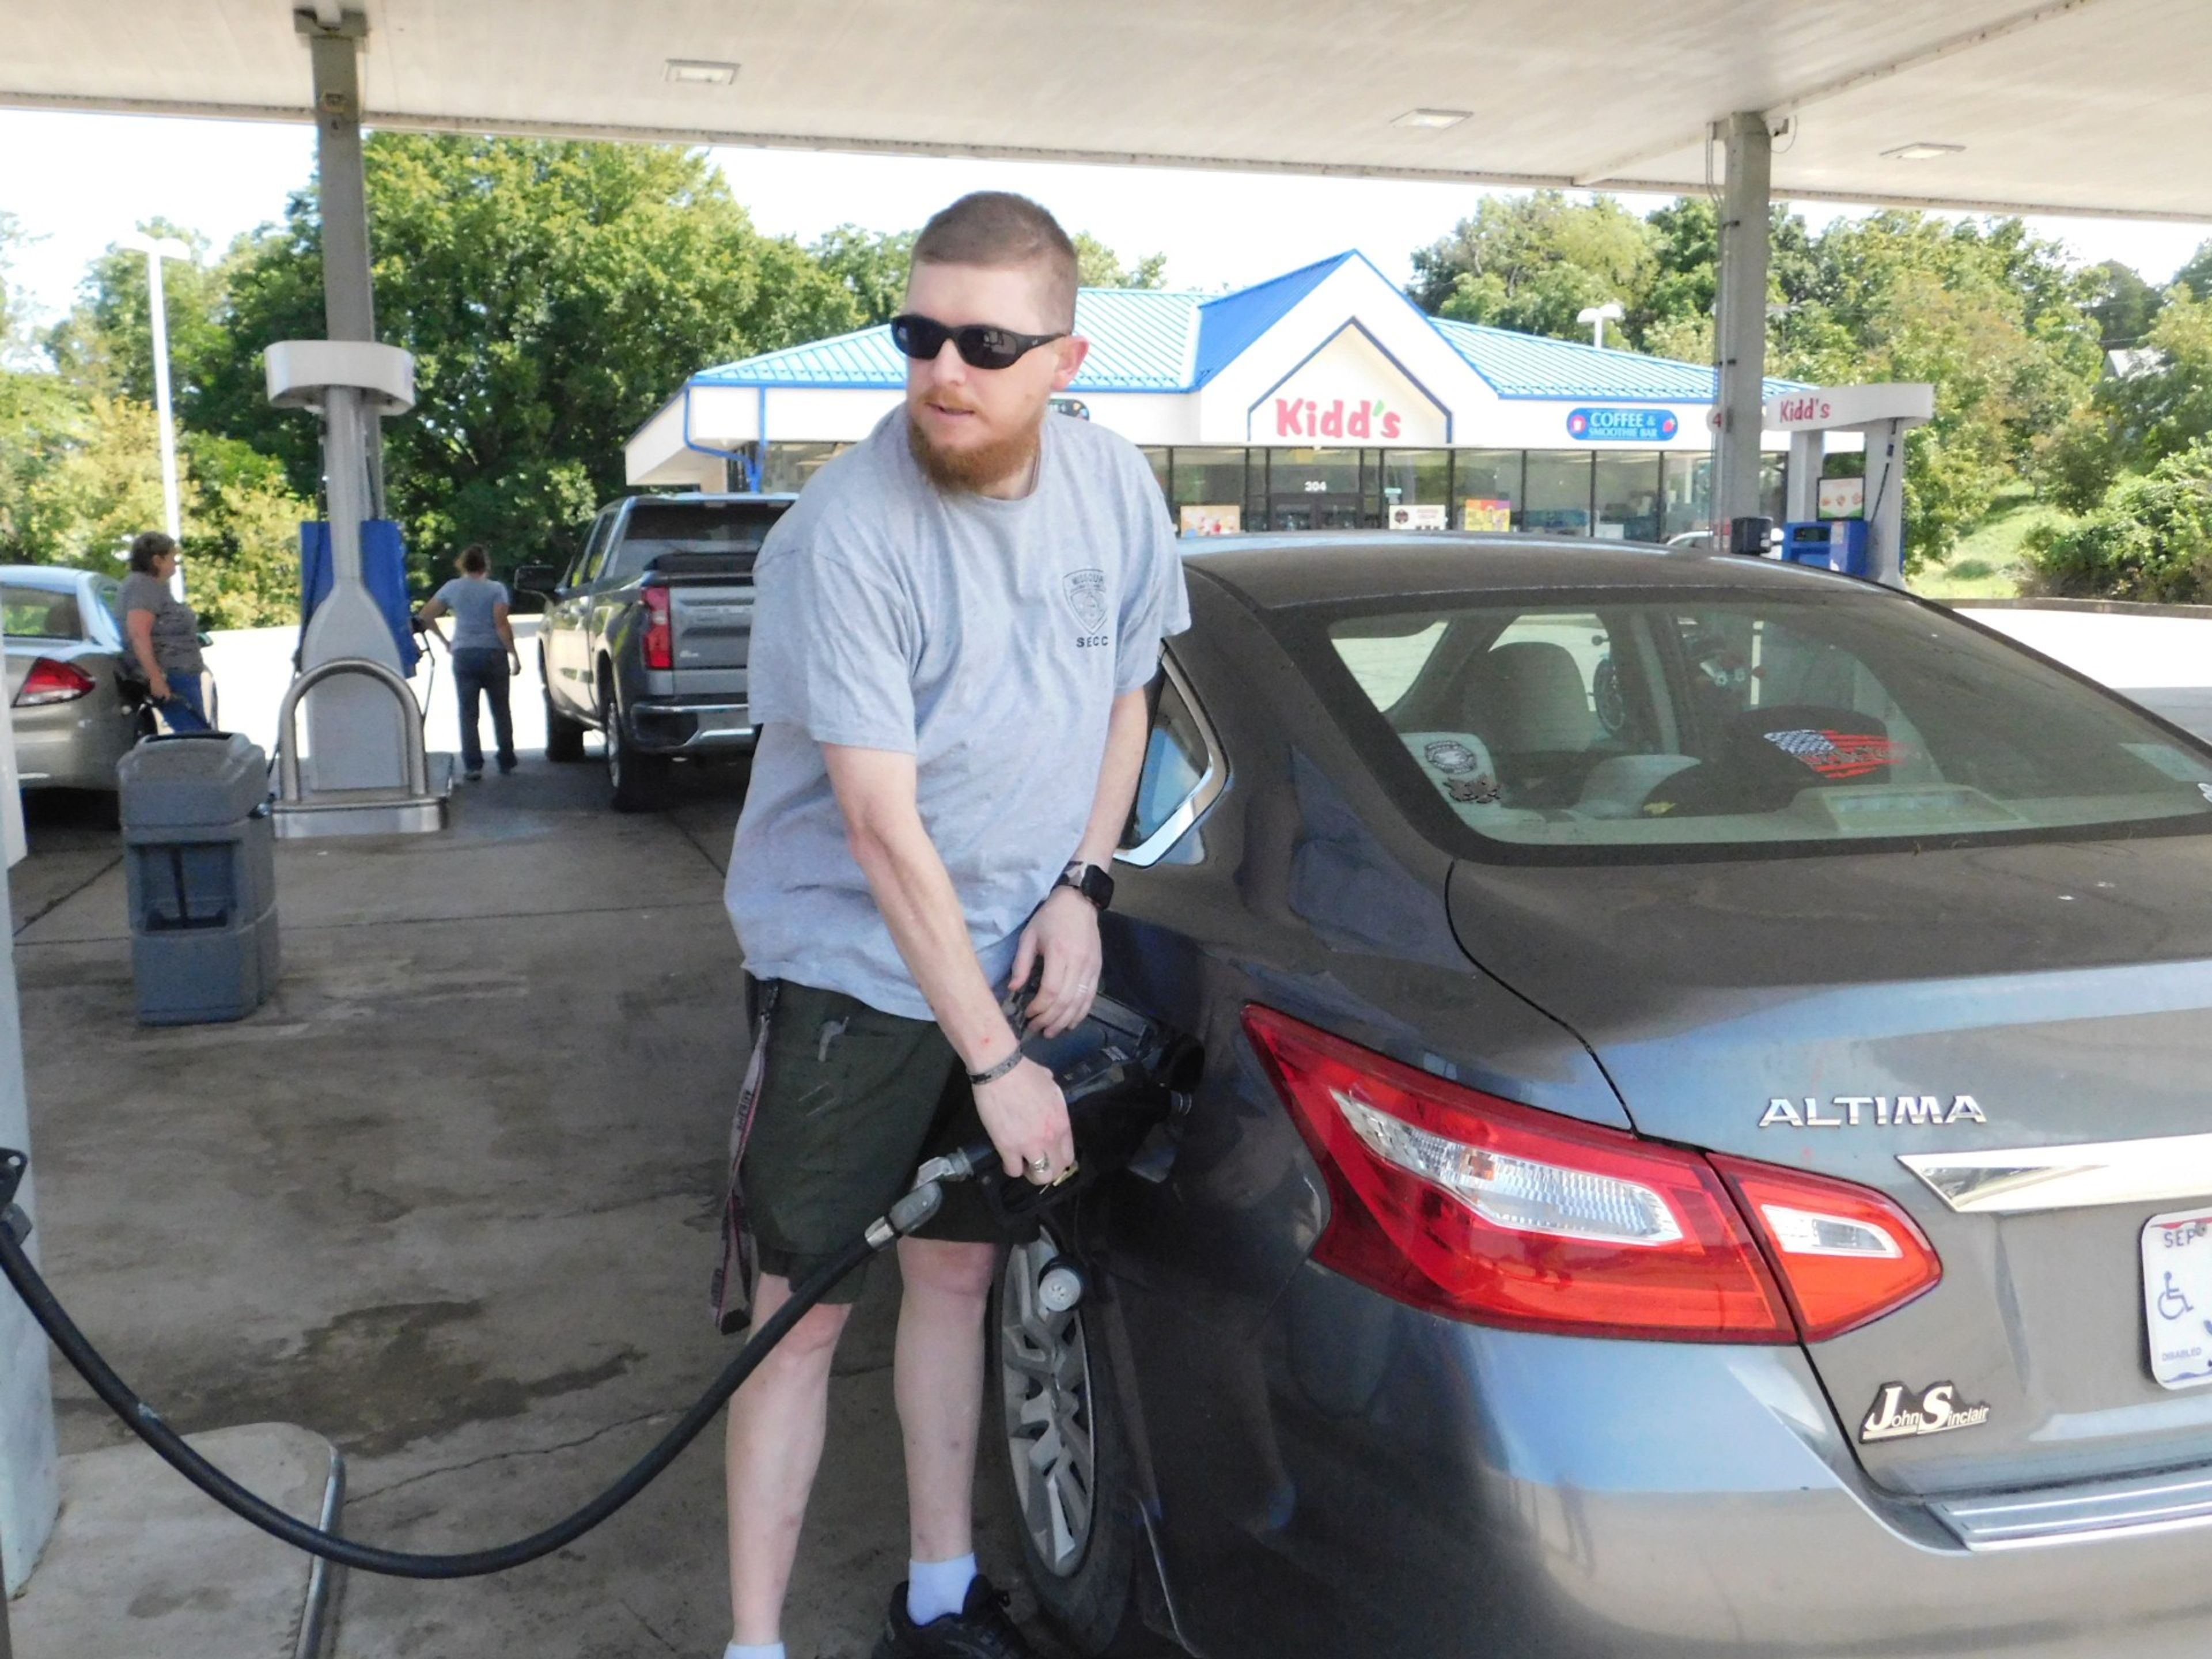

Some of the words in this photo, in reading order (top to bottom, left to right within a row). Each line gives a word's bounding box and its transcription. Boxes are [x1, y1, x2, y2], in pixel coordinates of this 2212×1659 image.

[1780, 398, 1830, 423] Kidd's
[1276, 398, 1401, 439] Kidd's
[1590, 412, 1643, 427] COFFEE
[1713, 413, 1722, 428] 4
[1304, 481, 1327, 492] 304
[1076, 636, 1109, 648] SECC
[1759, 1095, 1987, 1127] ALTIMA
[2163, 1229, 2196, 1248] SEP
[2162, 1347, 2202, 1362] DISABLED
